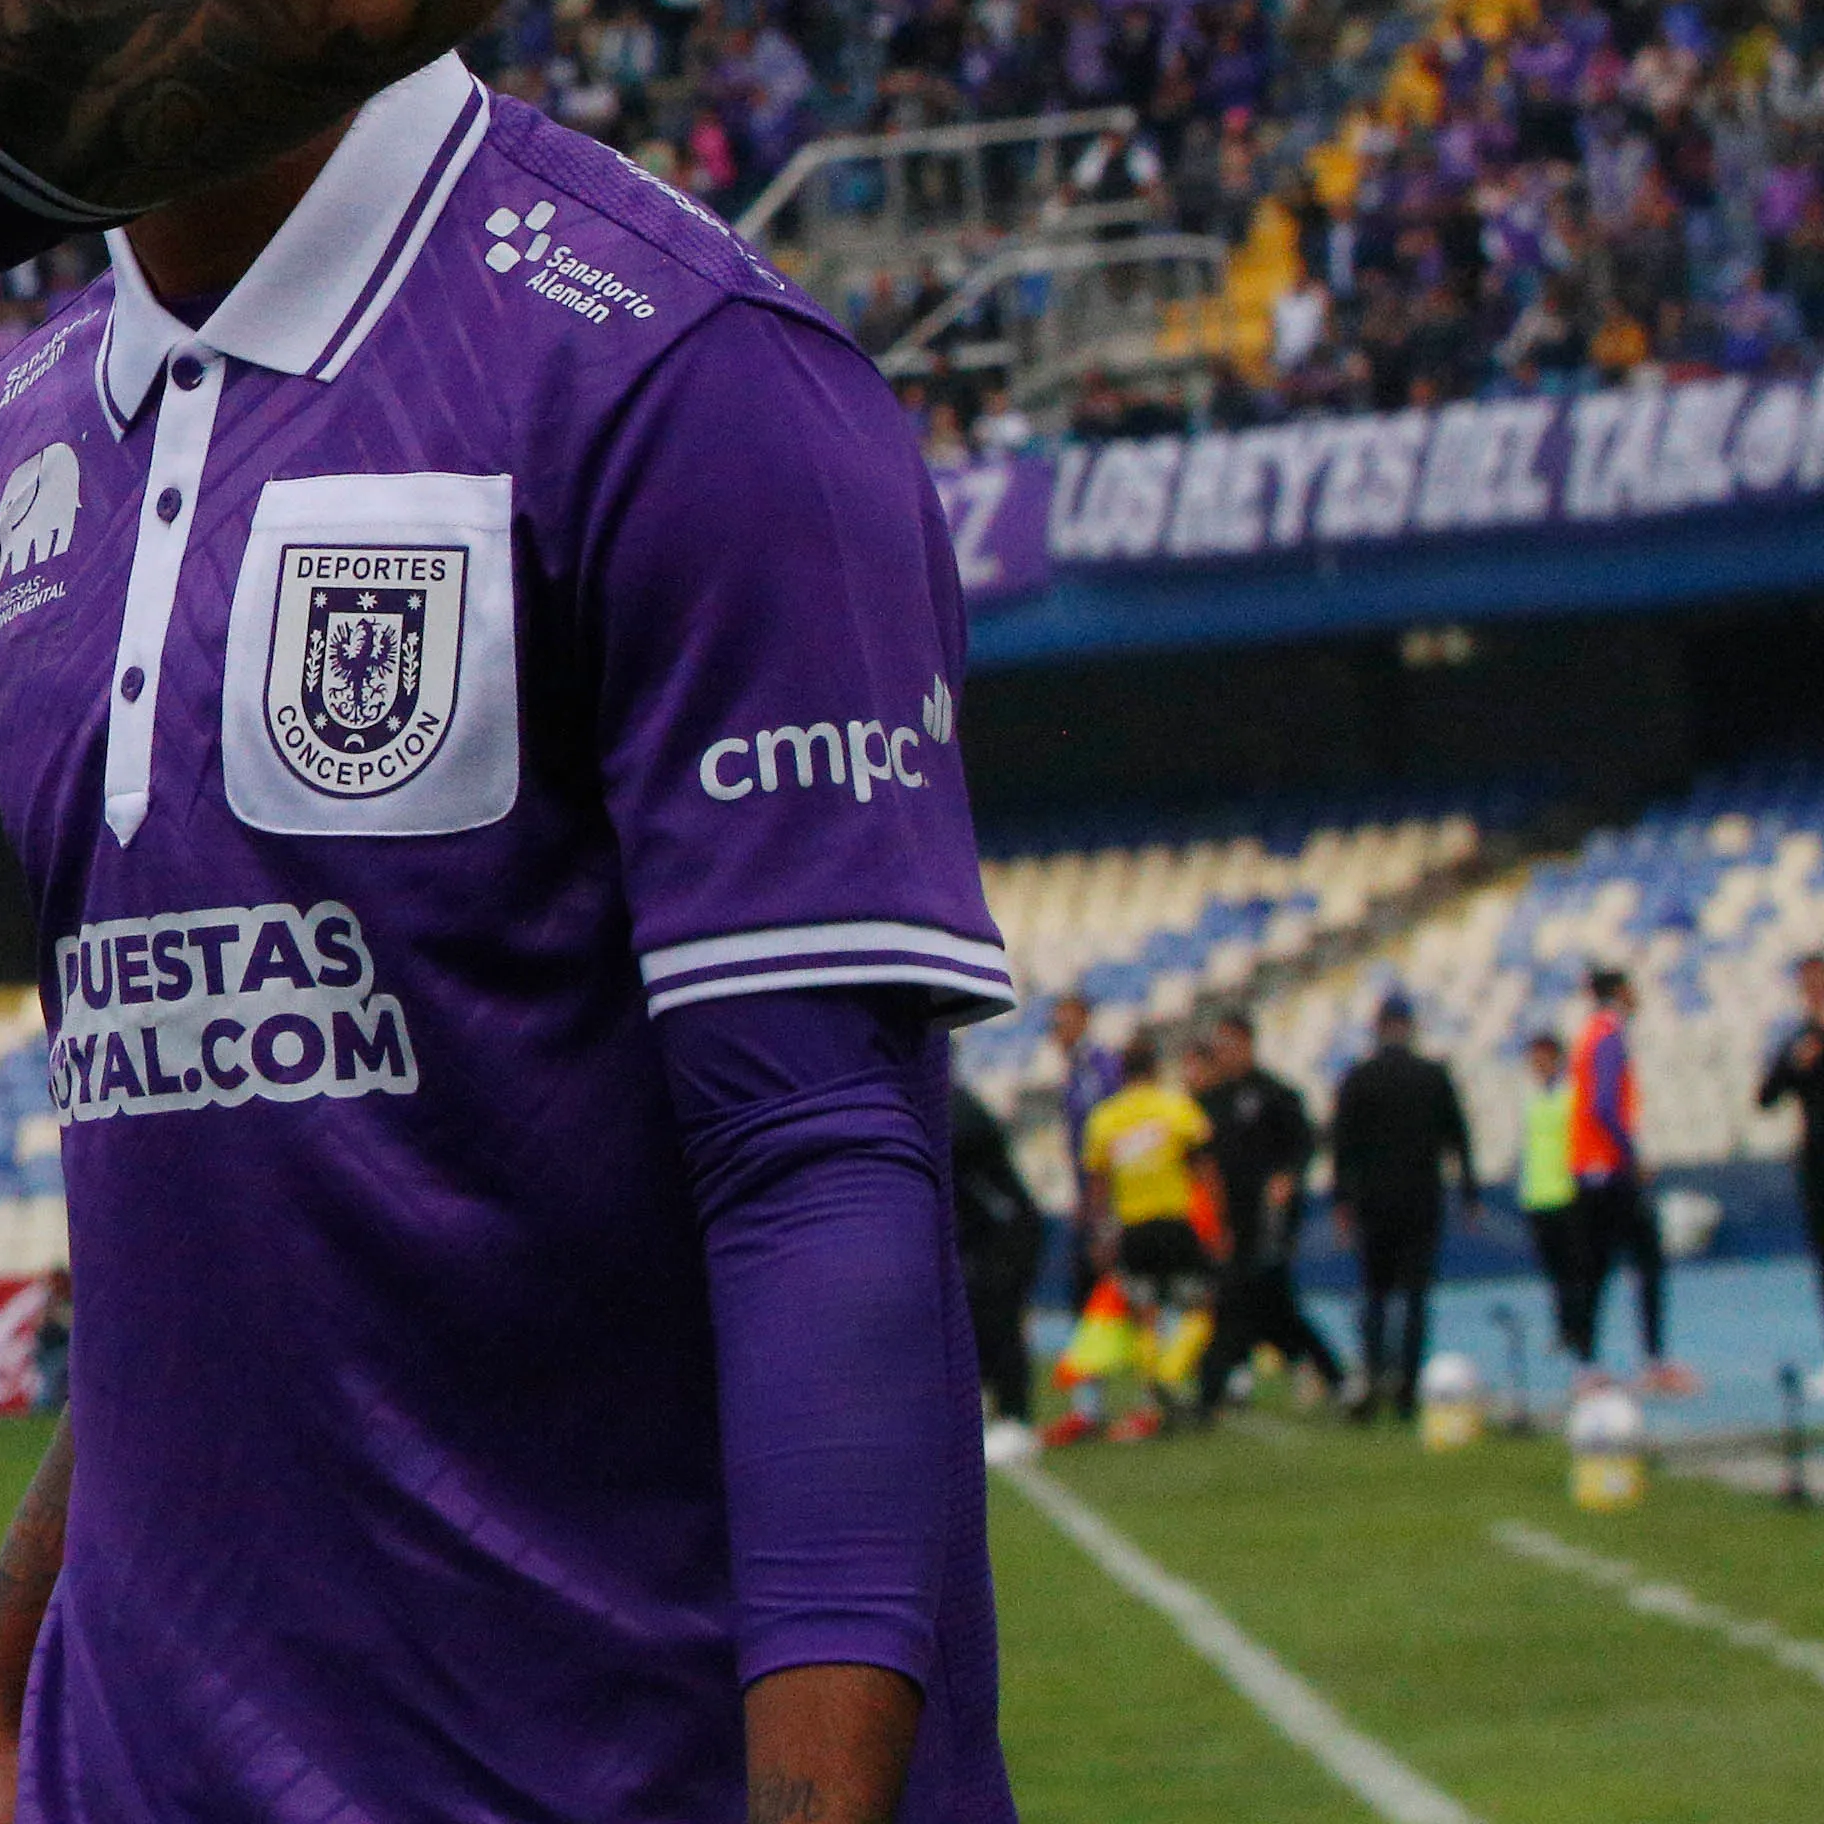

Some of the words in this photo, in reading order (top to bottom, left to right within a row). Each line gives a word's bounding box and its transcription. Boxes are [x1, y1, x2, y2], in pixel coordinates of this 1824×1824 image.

[525, 269, 611, 325] Alemán
[545, 245, 656, 321] Sanatorio
[296, 556, 447, 582] DEPORTES
[276, 704, 440, 786] CONCEPCION
[699, 719, 924, 803] cmpc
[64, 917, 363, 1015] PUESTAS
[50, 1009, 406, 1111] OYAL.COM
